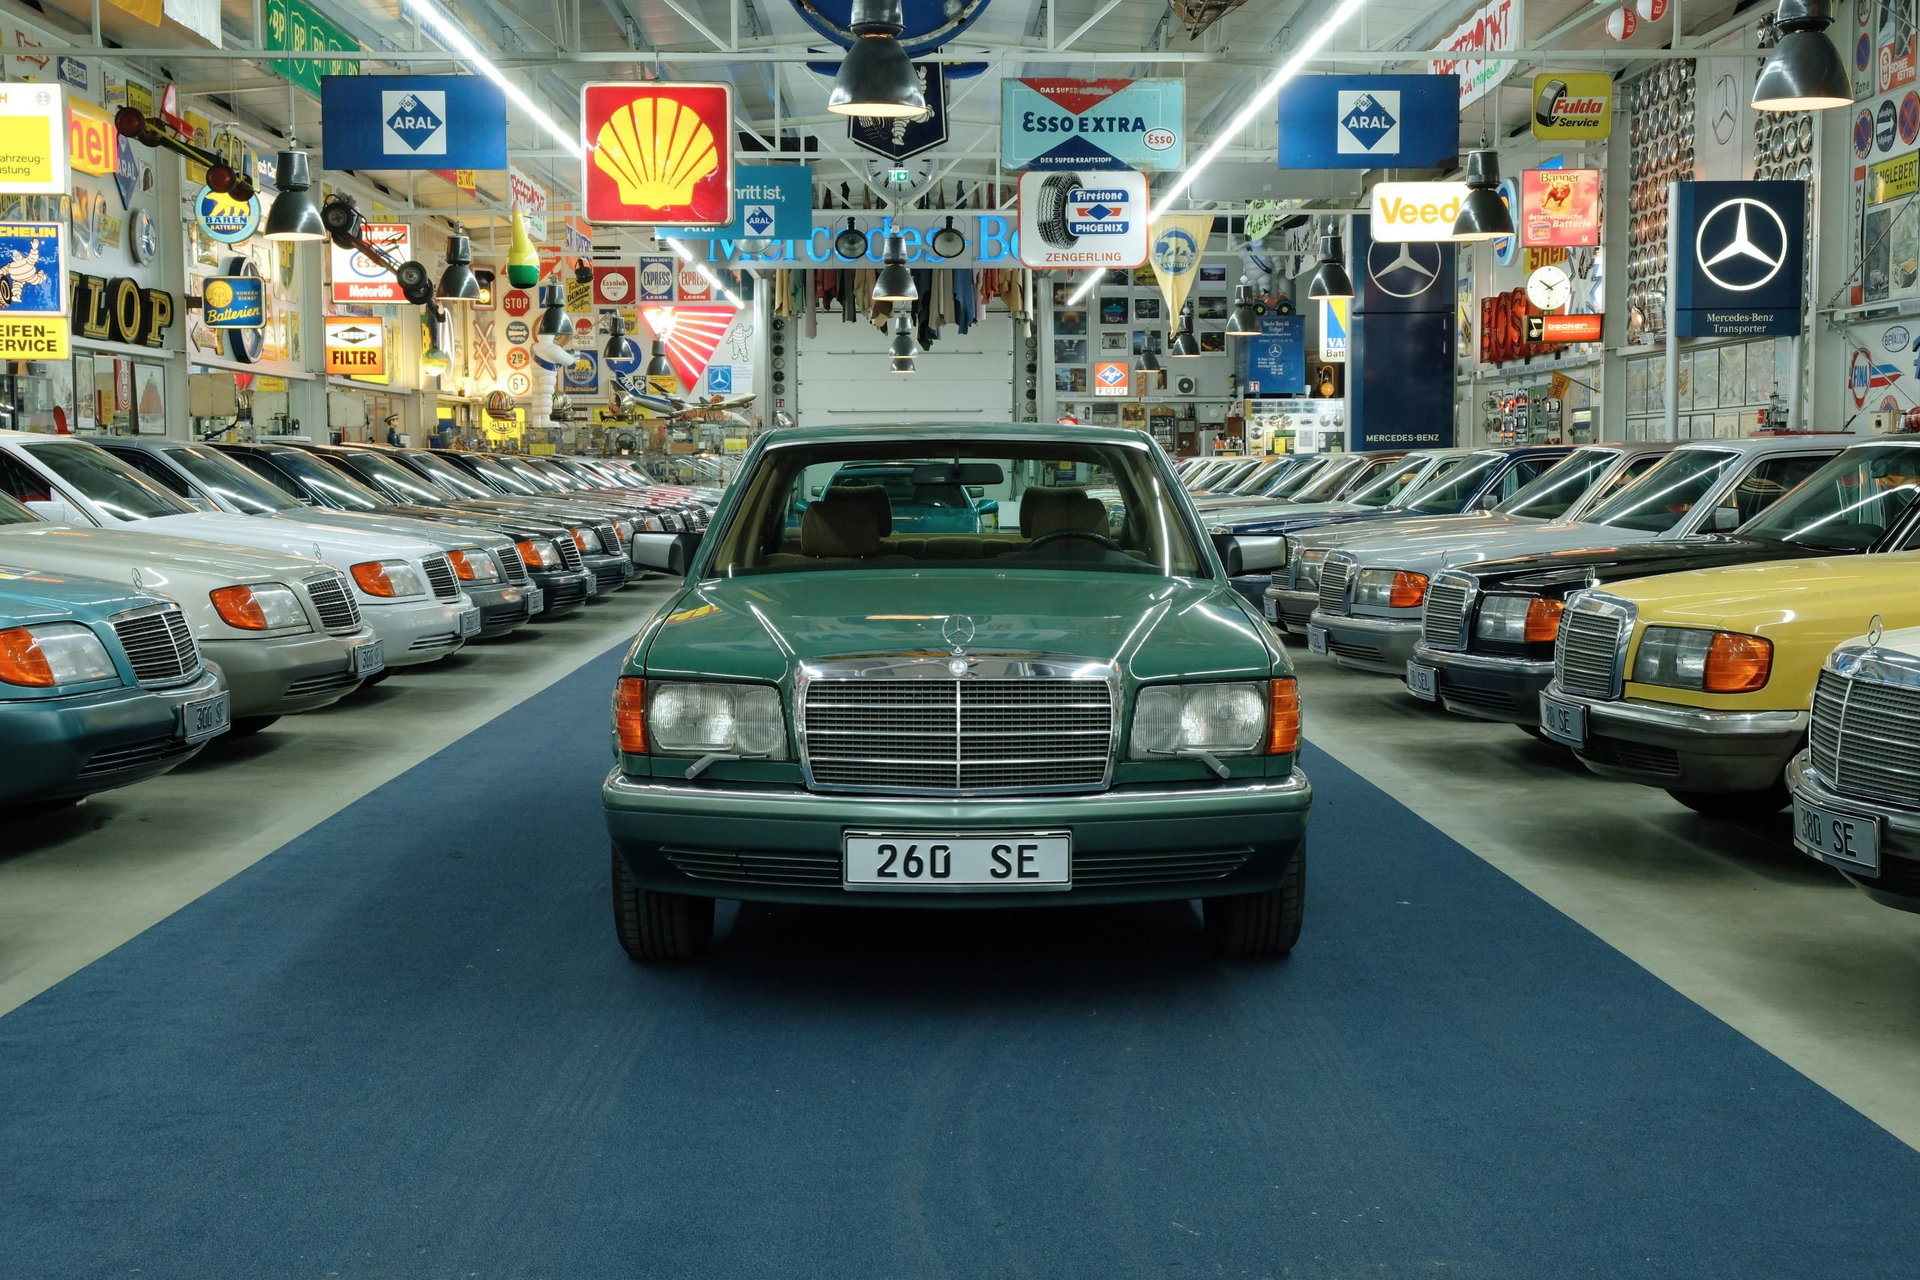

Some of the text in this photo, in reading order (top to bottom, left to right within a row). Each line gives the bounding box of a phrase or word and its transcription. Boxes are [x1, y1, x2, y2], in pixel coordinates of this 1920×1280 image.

[1626, 12, 1634, 33] ELAN
[1890, 57, 1908, 73] SCHNEE
[1896, 66, 1916, 82] KETTEN
[1855, 81, 1870, 95] Zone
[1552, 98, 1604, 115] Fulda
[393, 117, 436, 130] ARAL
[1078, 116, 1147, 133] EXTRA
[1347, 117, 1391, 130] ARAL
[1558, 117, 1600, 128] Service
[68, 106, 118, 170] hell
[0, 153, 44, 165] ahrzeug-
[1540, 172, 1579, 183] Banner
[1075, 190, 1123, 202] Firestone
[1379, 196, 1462, 225] Veed
[749, 216, 770, 225] ARAL
[1552, 219, 1592, 229] Batterie
[0, 225, 57, 238] CHELIN
[1076, 223, 1123, 233] PHOENIX
[1853, 185, 1861, 282] MOTANOL
[1045, 251, 1122, 263] ZENGERLING
[602, 279, 627, 287] Essolub
[643, 271, 671, 286] EXPRESS
[348, 284, 394, 298] Motoröle
[567, 285, 590, 303] DUNLOP
[504, 297, 529, 309] STOP
[206, 305, 261, 324] Batterien
[1706, 313, 1774, 323] Mercedes-Benz
[0, 325, 56, 338] EIFEN-
[1713, 323, 1767, 335] Transporter
[0, 339, 58, 352] ERVICE
[332, 350, 377, 366] FILTER
[1854, 365, 1868, 388] FINA
[1098, 387, 1125, 395] FOTO
[1366, 434, 1440, 442] MERCEDES-BENZ
[362, 649, 375, 669] 300
[195, 700, 225, 731] 300 SE
[1558, 707, 1571, 734] SE
[1800, 805, 1857, 858] 380 SE
[876, 843, 1040, 879] 260 SE
